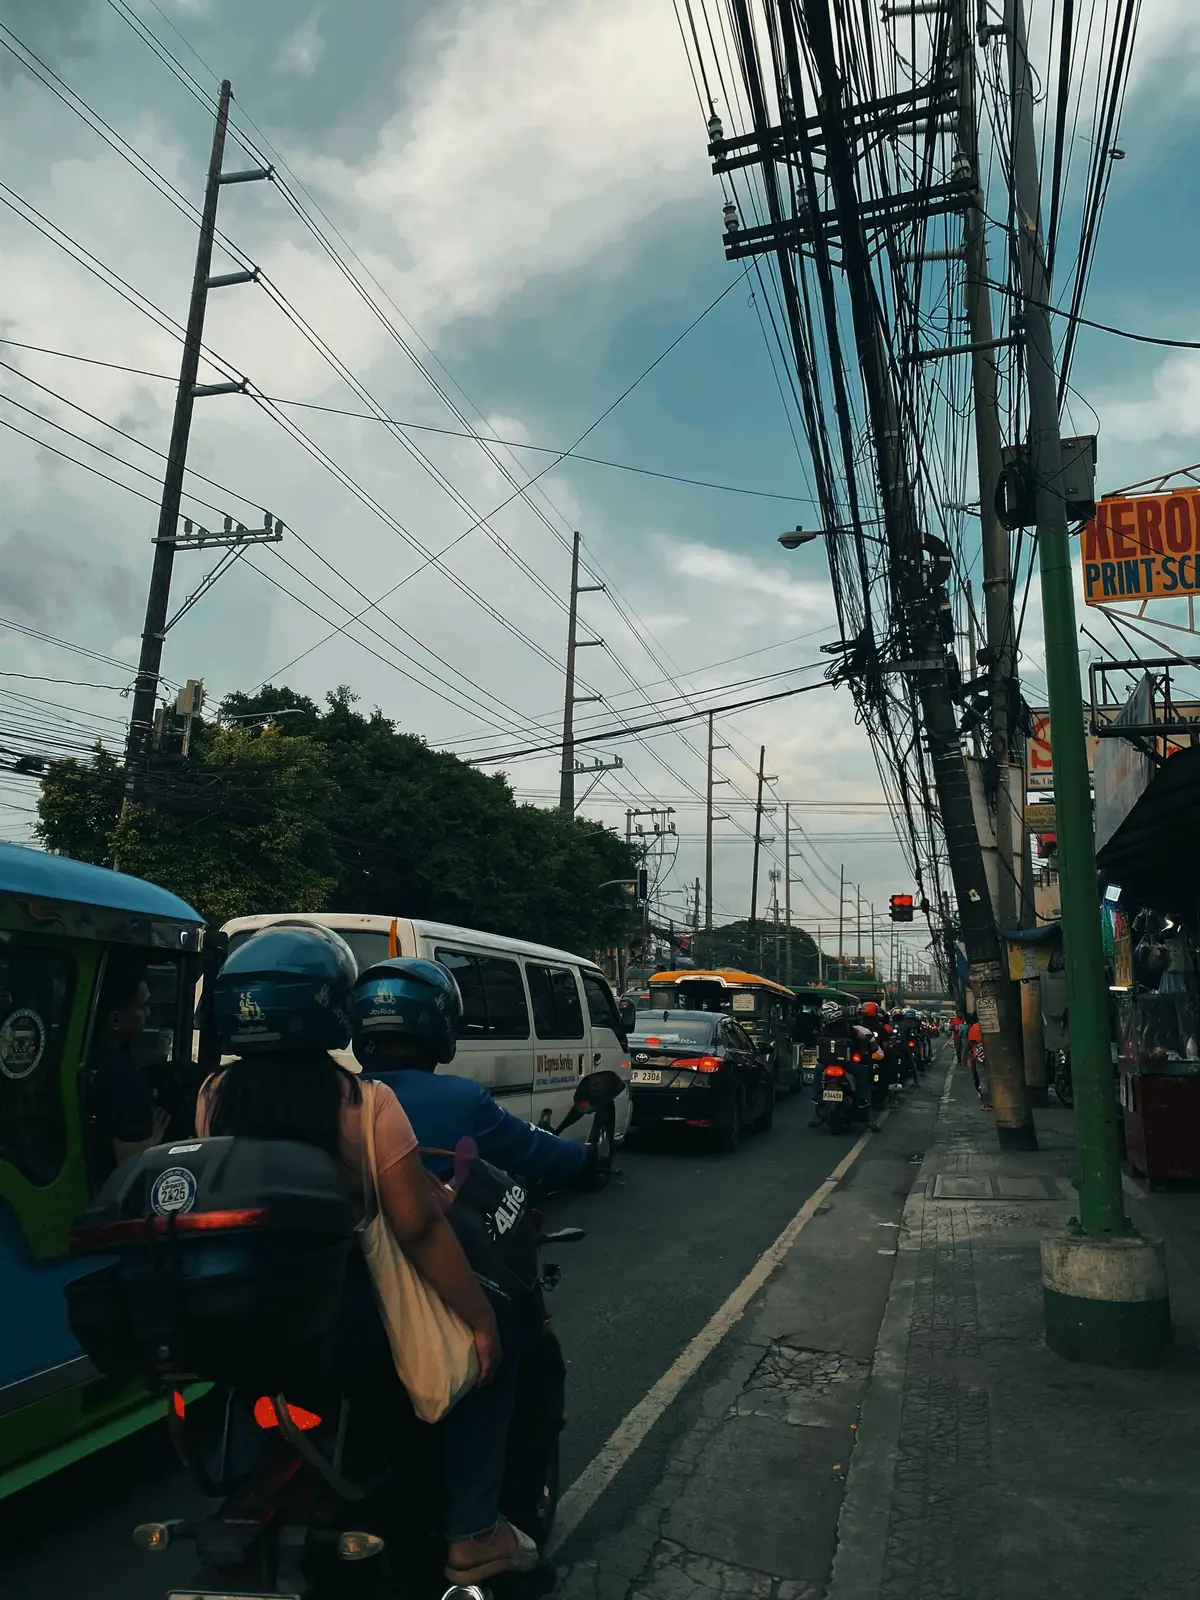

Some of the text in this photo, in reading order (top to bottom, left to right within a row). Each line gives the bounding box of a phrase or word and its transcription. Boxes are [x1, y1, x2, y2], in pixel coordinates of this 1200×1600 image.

[370, 1008, 395, 1016] JoyRide
[642, 1072, 660, 1081] 2306
[162, 1182, 184, 1190] UPDATE
[494, 1185, 525, 1235] 4Life
